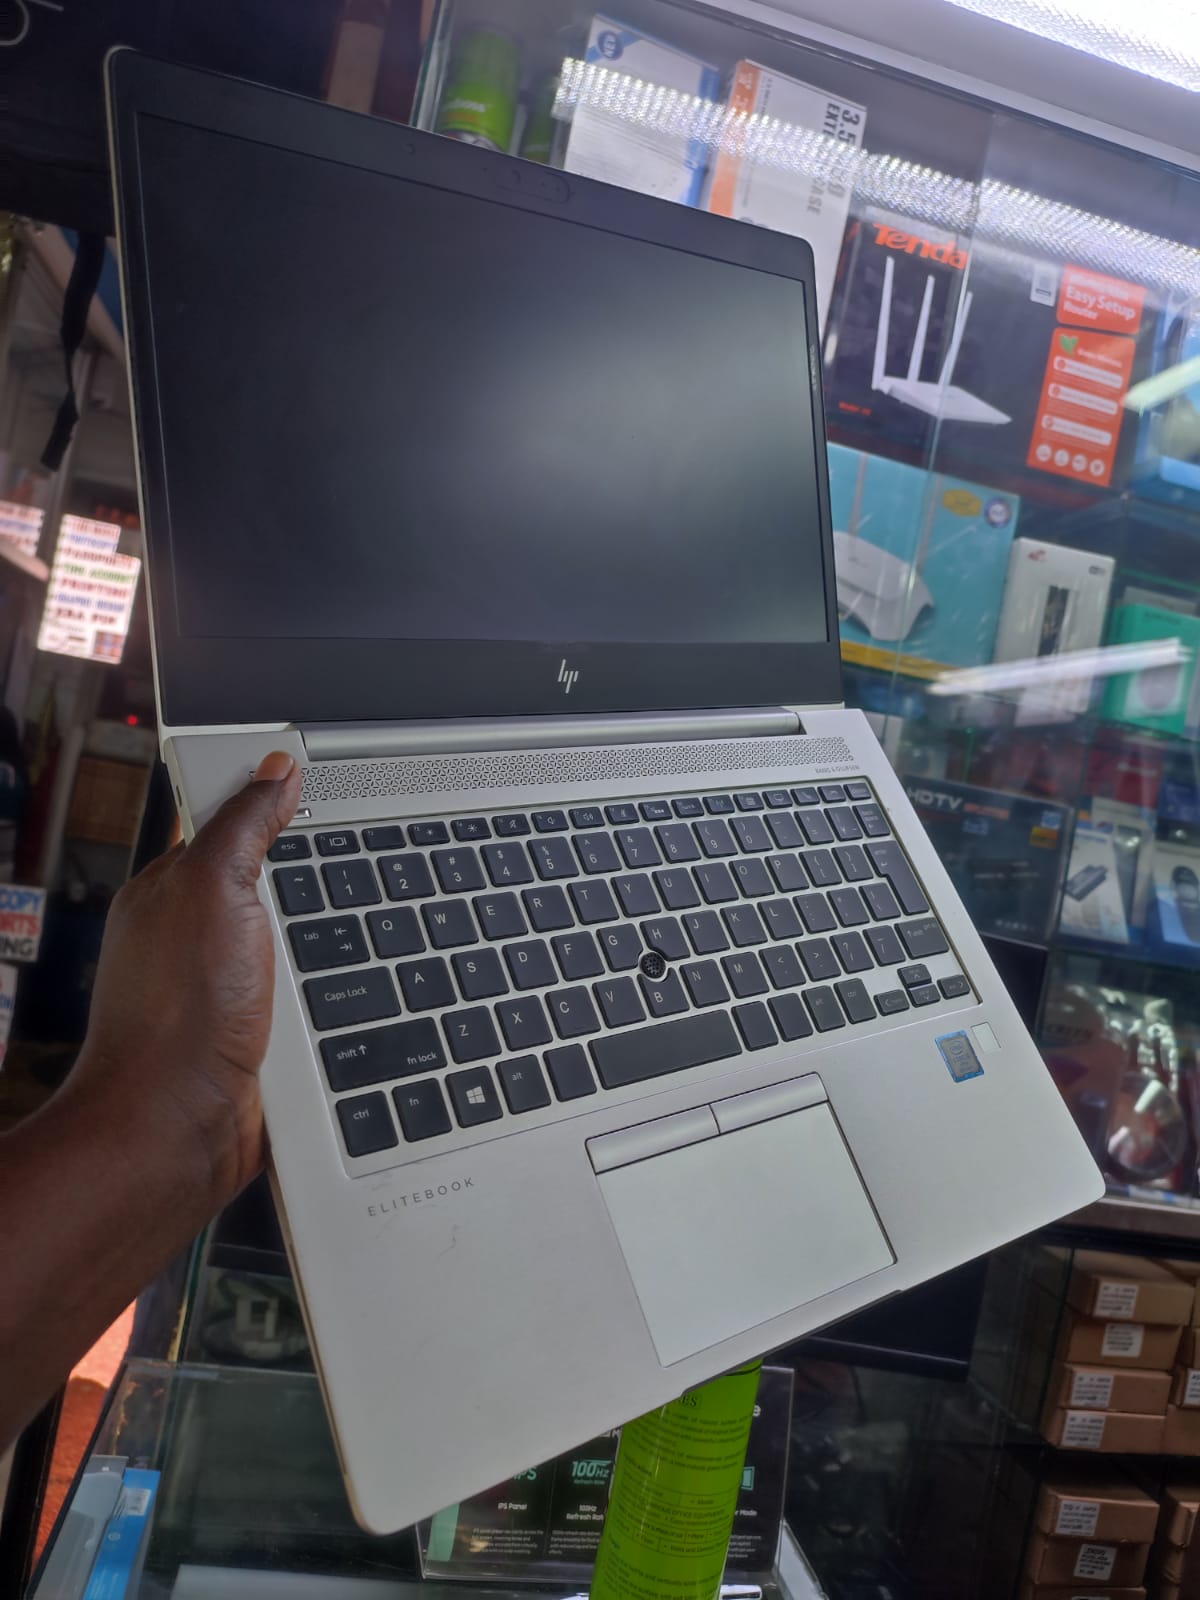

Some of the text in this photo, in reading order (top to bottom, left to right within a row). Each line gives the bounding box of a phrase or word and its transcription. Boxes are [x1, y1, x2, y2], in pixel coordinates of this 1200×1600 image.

[872, 222, 968, 270] Tenda
[1065, 286, 1096, 308] Easy
[1096, 295, 1136, 320] Setup
[558, 658, 579, 694] hp
[907, 787, 963, 811] HDTV
[710, 839, 718, 849] 9
[745, 835, 753, 844] 0
[281, 842, 296, 851] esc
[669, 844, 678, 854] 8
[632, 848, 638, 857] 7
[546, 859, 554, 870] 5
[589, 854, 598, 864] 6
[773, 860, 781, 869] P
[503, 866, 511, 877] 4
[739, 865, 748, 875] O
[453, 872, 462, 882] 3
[664, 877, 673, 888] U
[704, 873, 710, 883] I
[400, 879, 409, 889] 2
[624, 883, 631, 893] Y
[345, 884, 353, 896] 1
[580, 889, 589, 900] T
[533, 898, 543, 908] R
[486, 905, 496, 916] E
[769, 906, 778, 917] L
[435, 913, 447, 925] W
[730, 912, 741, 923] K
[382, 919, 393, 931] Q
[692, 919, 700, 929] J
[303, 931, 320, 942] tab
[651, 928, 662, 939] H
[608, 935, 618, 946] G
[564, 943, 572, 955] F
[518, 952, 528, 963] D
[466, 961, 477, 973] S
[734, 963, 743, 974] M
[414, 972, 425, 984] A
[692, 970, 701, 981] N
[324, 986, 368, 1001] Caps Lock
[605, 991, 614, 1003] V
[653, 991, 664, 1003] B
[559, 1001, 570, 1013] C
[512, 1012, 522, 1024] X
[459, 1024, 469, 1037] Z
[336, 1048, 358, 1060] shift
[407, 1051, 438, 1065] fn lock
[512, 1072, 523, 1081] alt
[409, 1097, 420, 1107] fn
[352, 1108, 370, 1120] ctrl
[366, 1177, 475, 1217] ELITEBOOK
